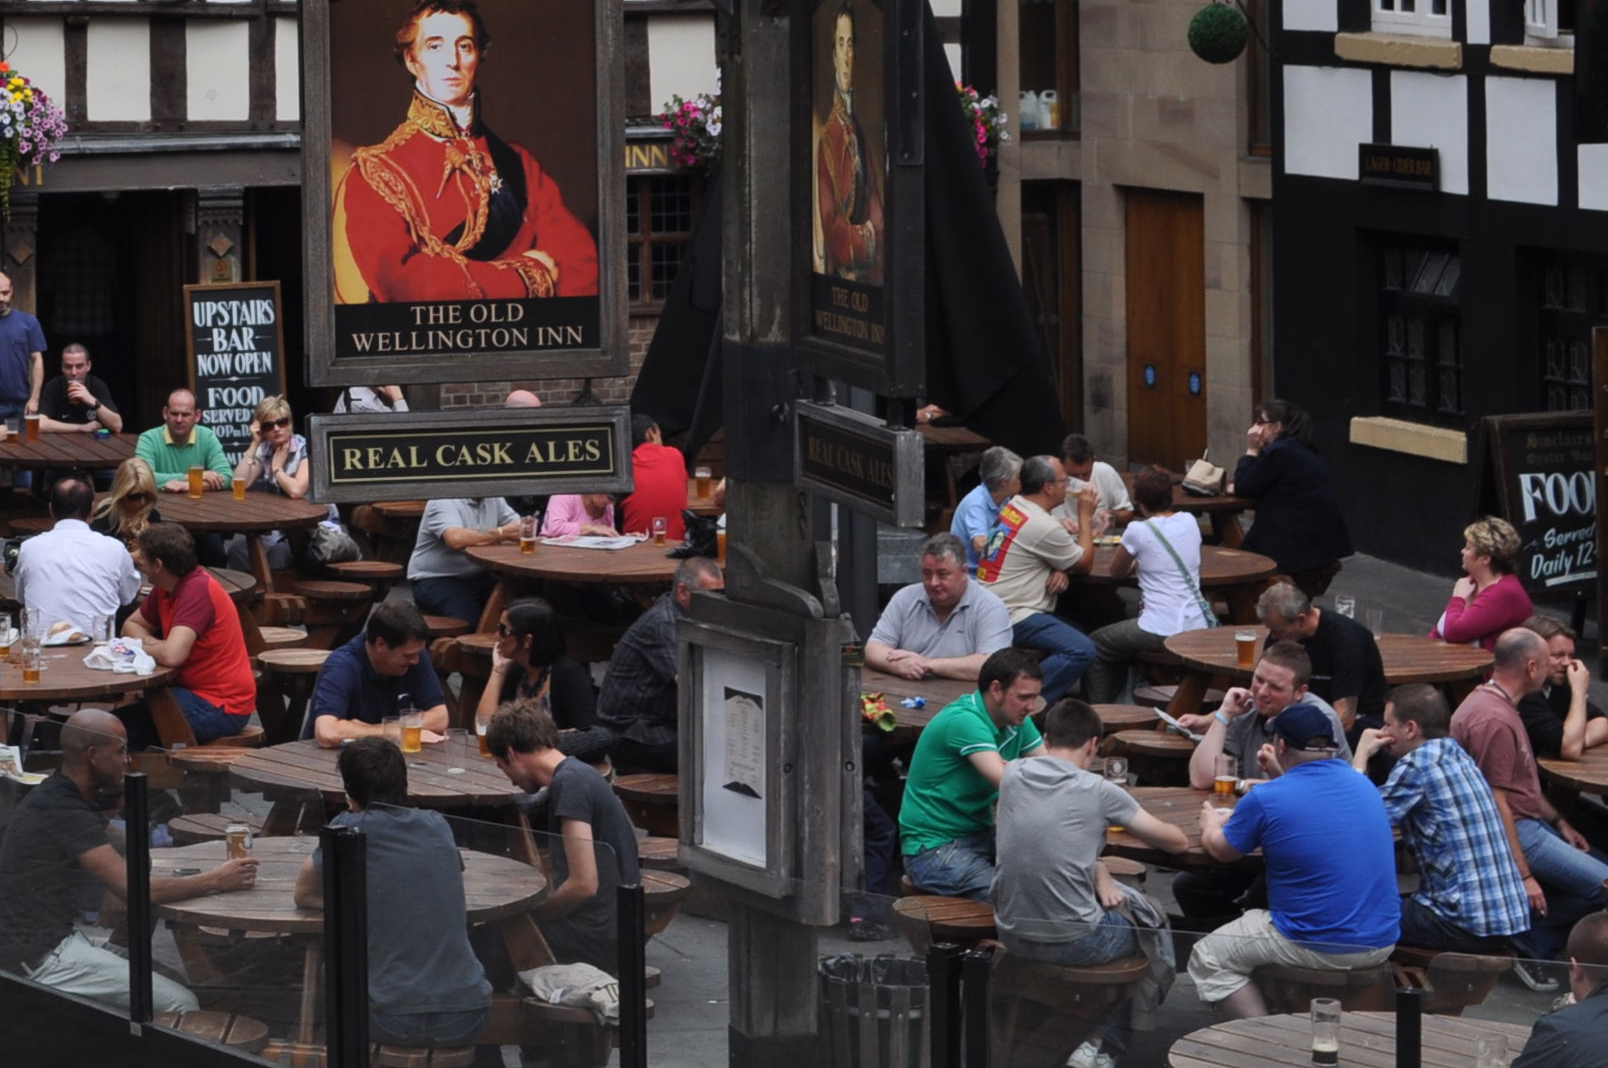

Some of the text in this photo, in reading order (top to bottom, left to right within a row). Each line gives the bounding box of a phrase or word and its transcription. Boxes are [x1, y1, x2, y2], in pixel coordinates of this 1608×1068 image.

[625, 145, 668, 167] INN
[832, 287, 869, 312] THE OLD
[193, 299, 275, 327] UPSTAIRS
[411, 303, 524, 325] THE OLD
[816, 309, 868, 340] WELLINGTON
[212, 327, 256, 352] BAR
[352, 326, 583, 352] WELLINGTON INN
[197, 352, 272, 376] NOW OPEN
[208, 386, 265, 408] FOOD
[203, 408, 251, 424] SERVED
[343, 439, 601, 470] REAL CASK ALES
[808, 436, 833, 467] REAL
[837, 446, 864, 478] CASK
[1518, 470, 1596, 522] FOO
[1531, 549, 1573, 580] Daily
